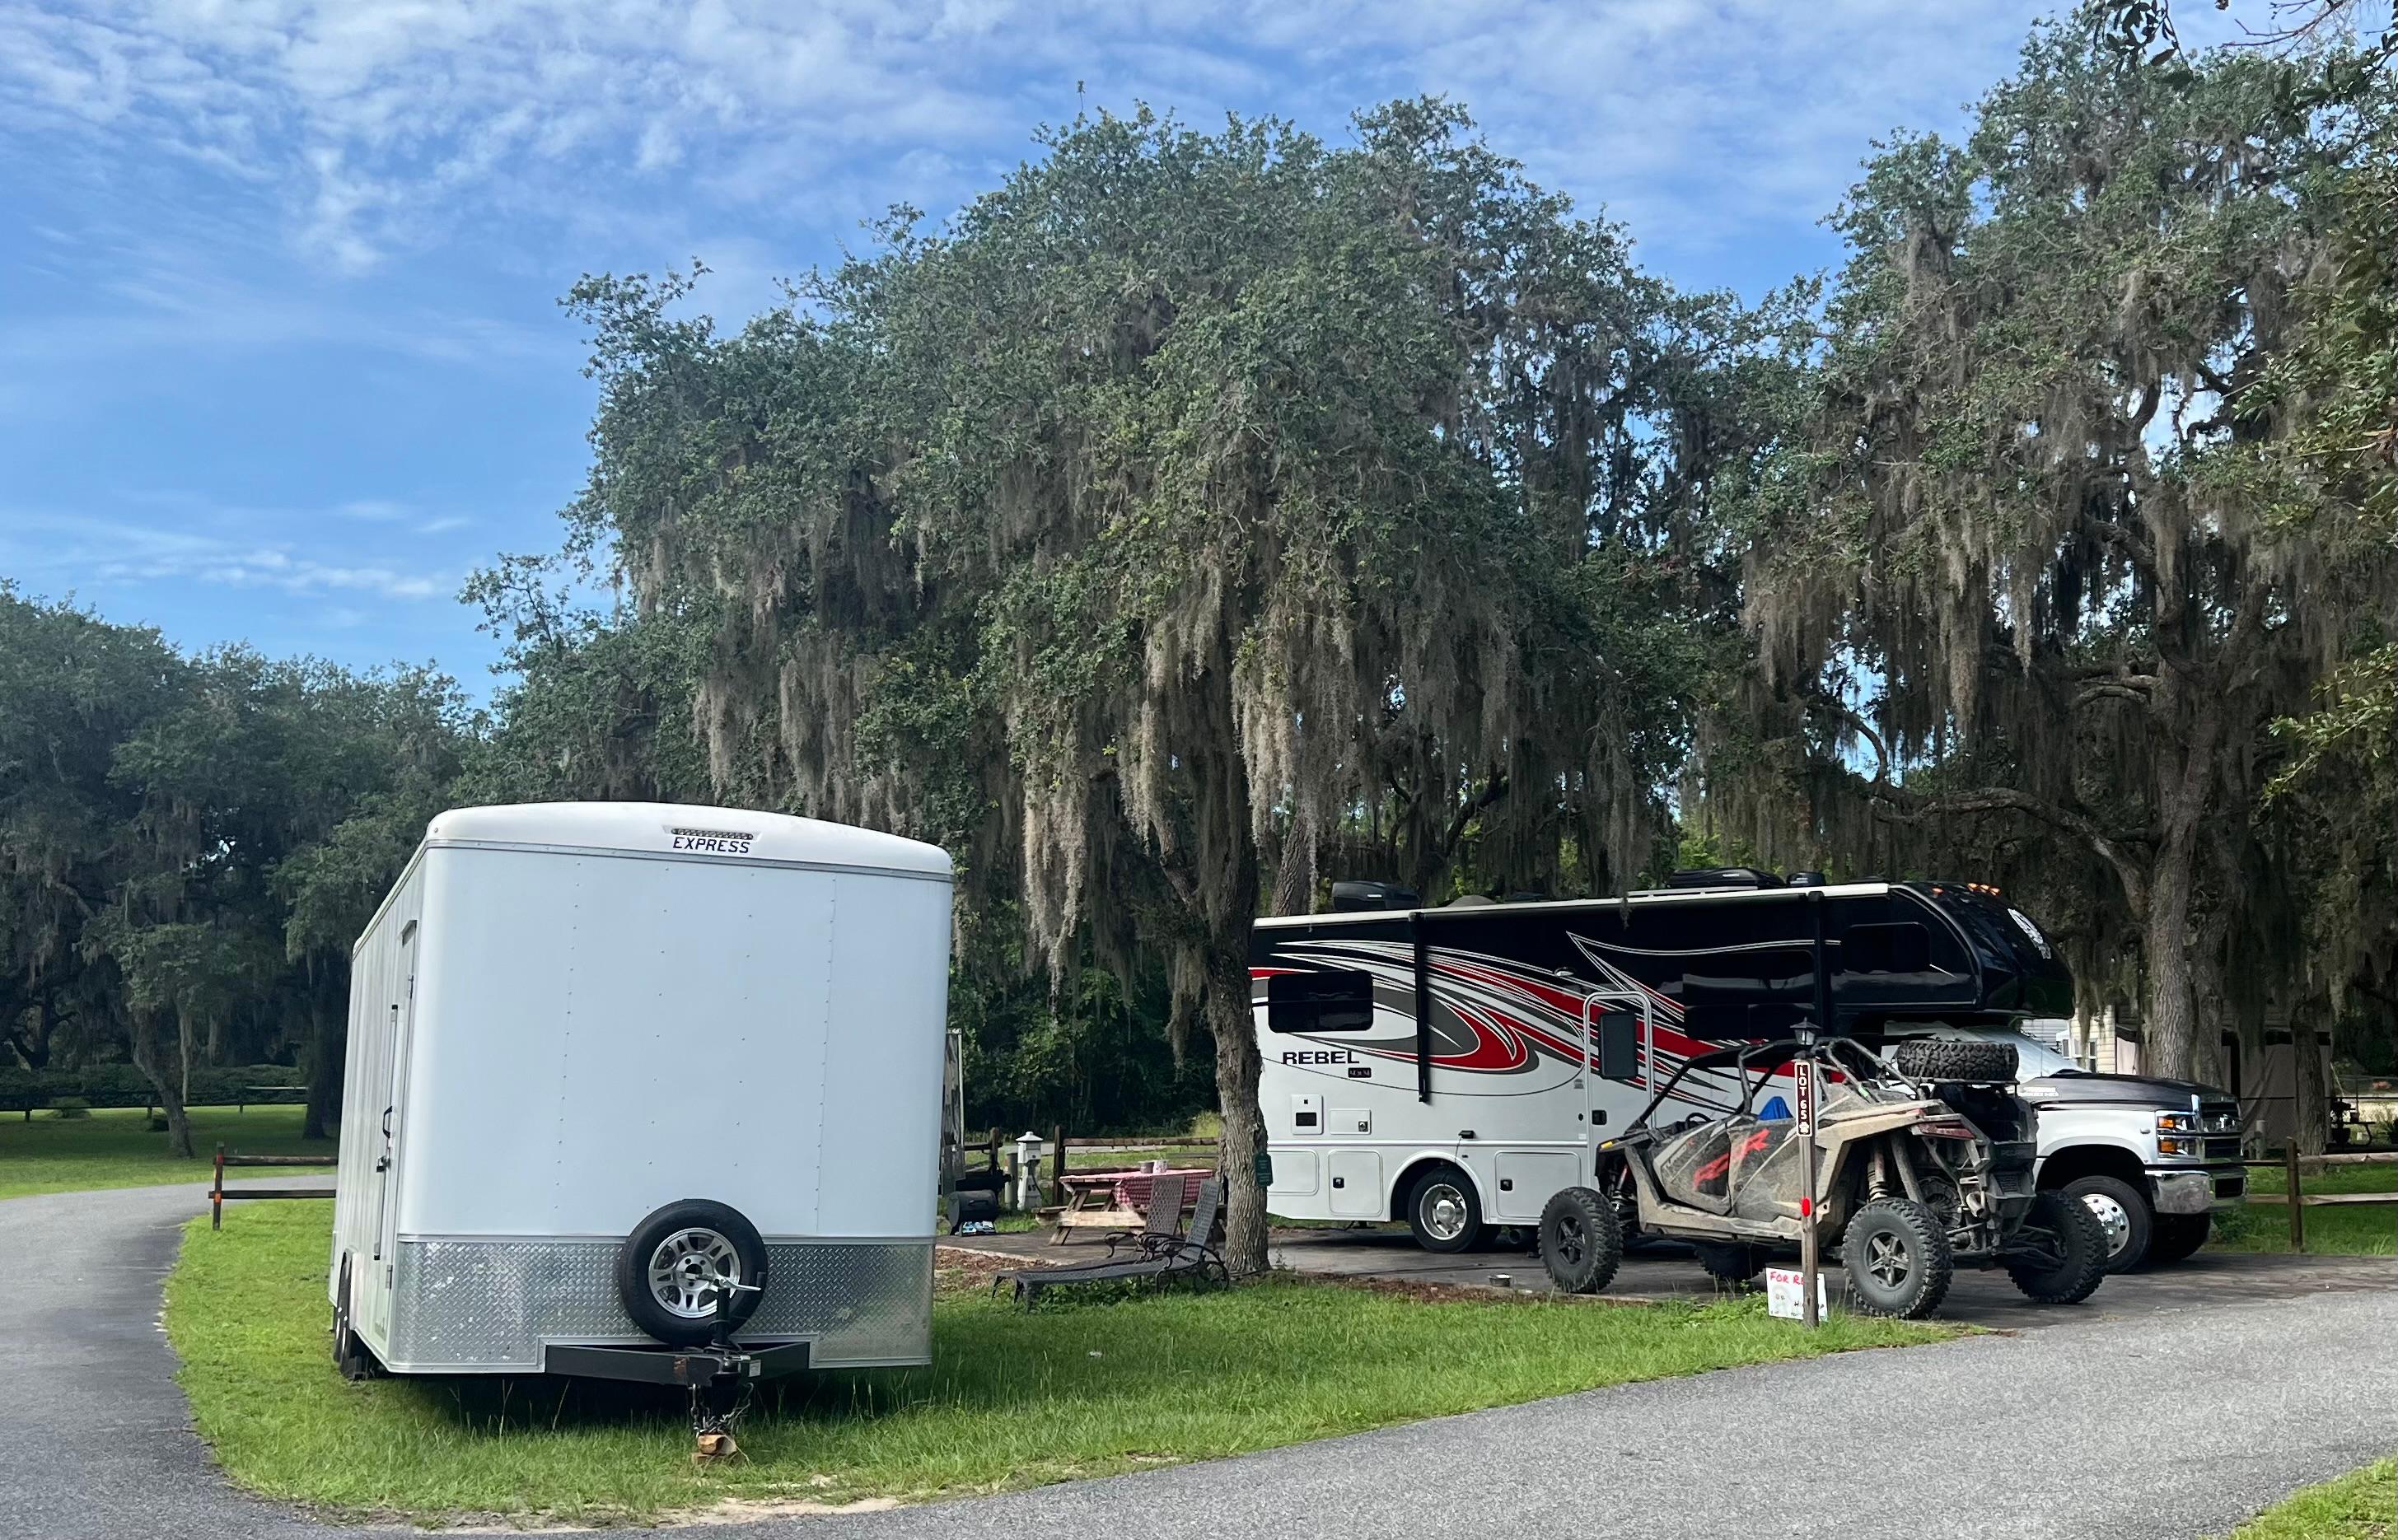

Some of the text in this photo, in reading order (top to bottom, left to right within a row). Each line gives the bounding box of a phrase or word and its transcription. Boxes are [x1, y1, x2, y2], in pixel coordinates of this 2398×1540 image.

[672, 836, 750, 853] EXPRESS
[1282, 1051, 1360, 1065] REBEL
[1798, 1066, 1808, 1120] LOT 65
[1770, 1271, 1789, 1284] FOR
